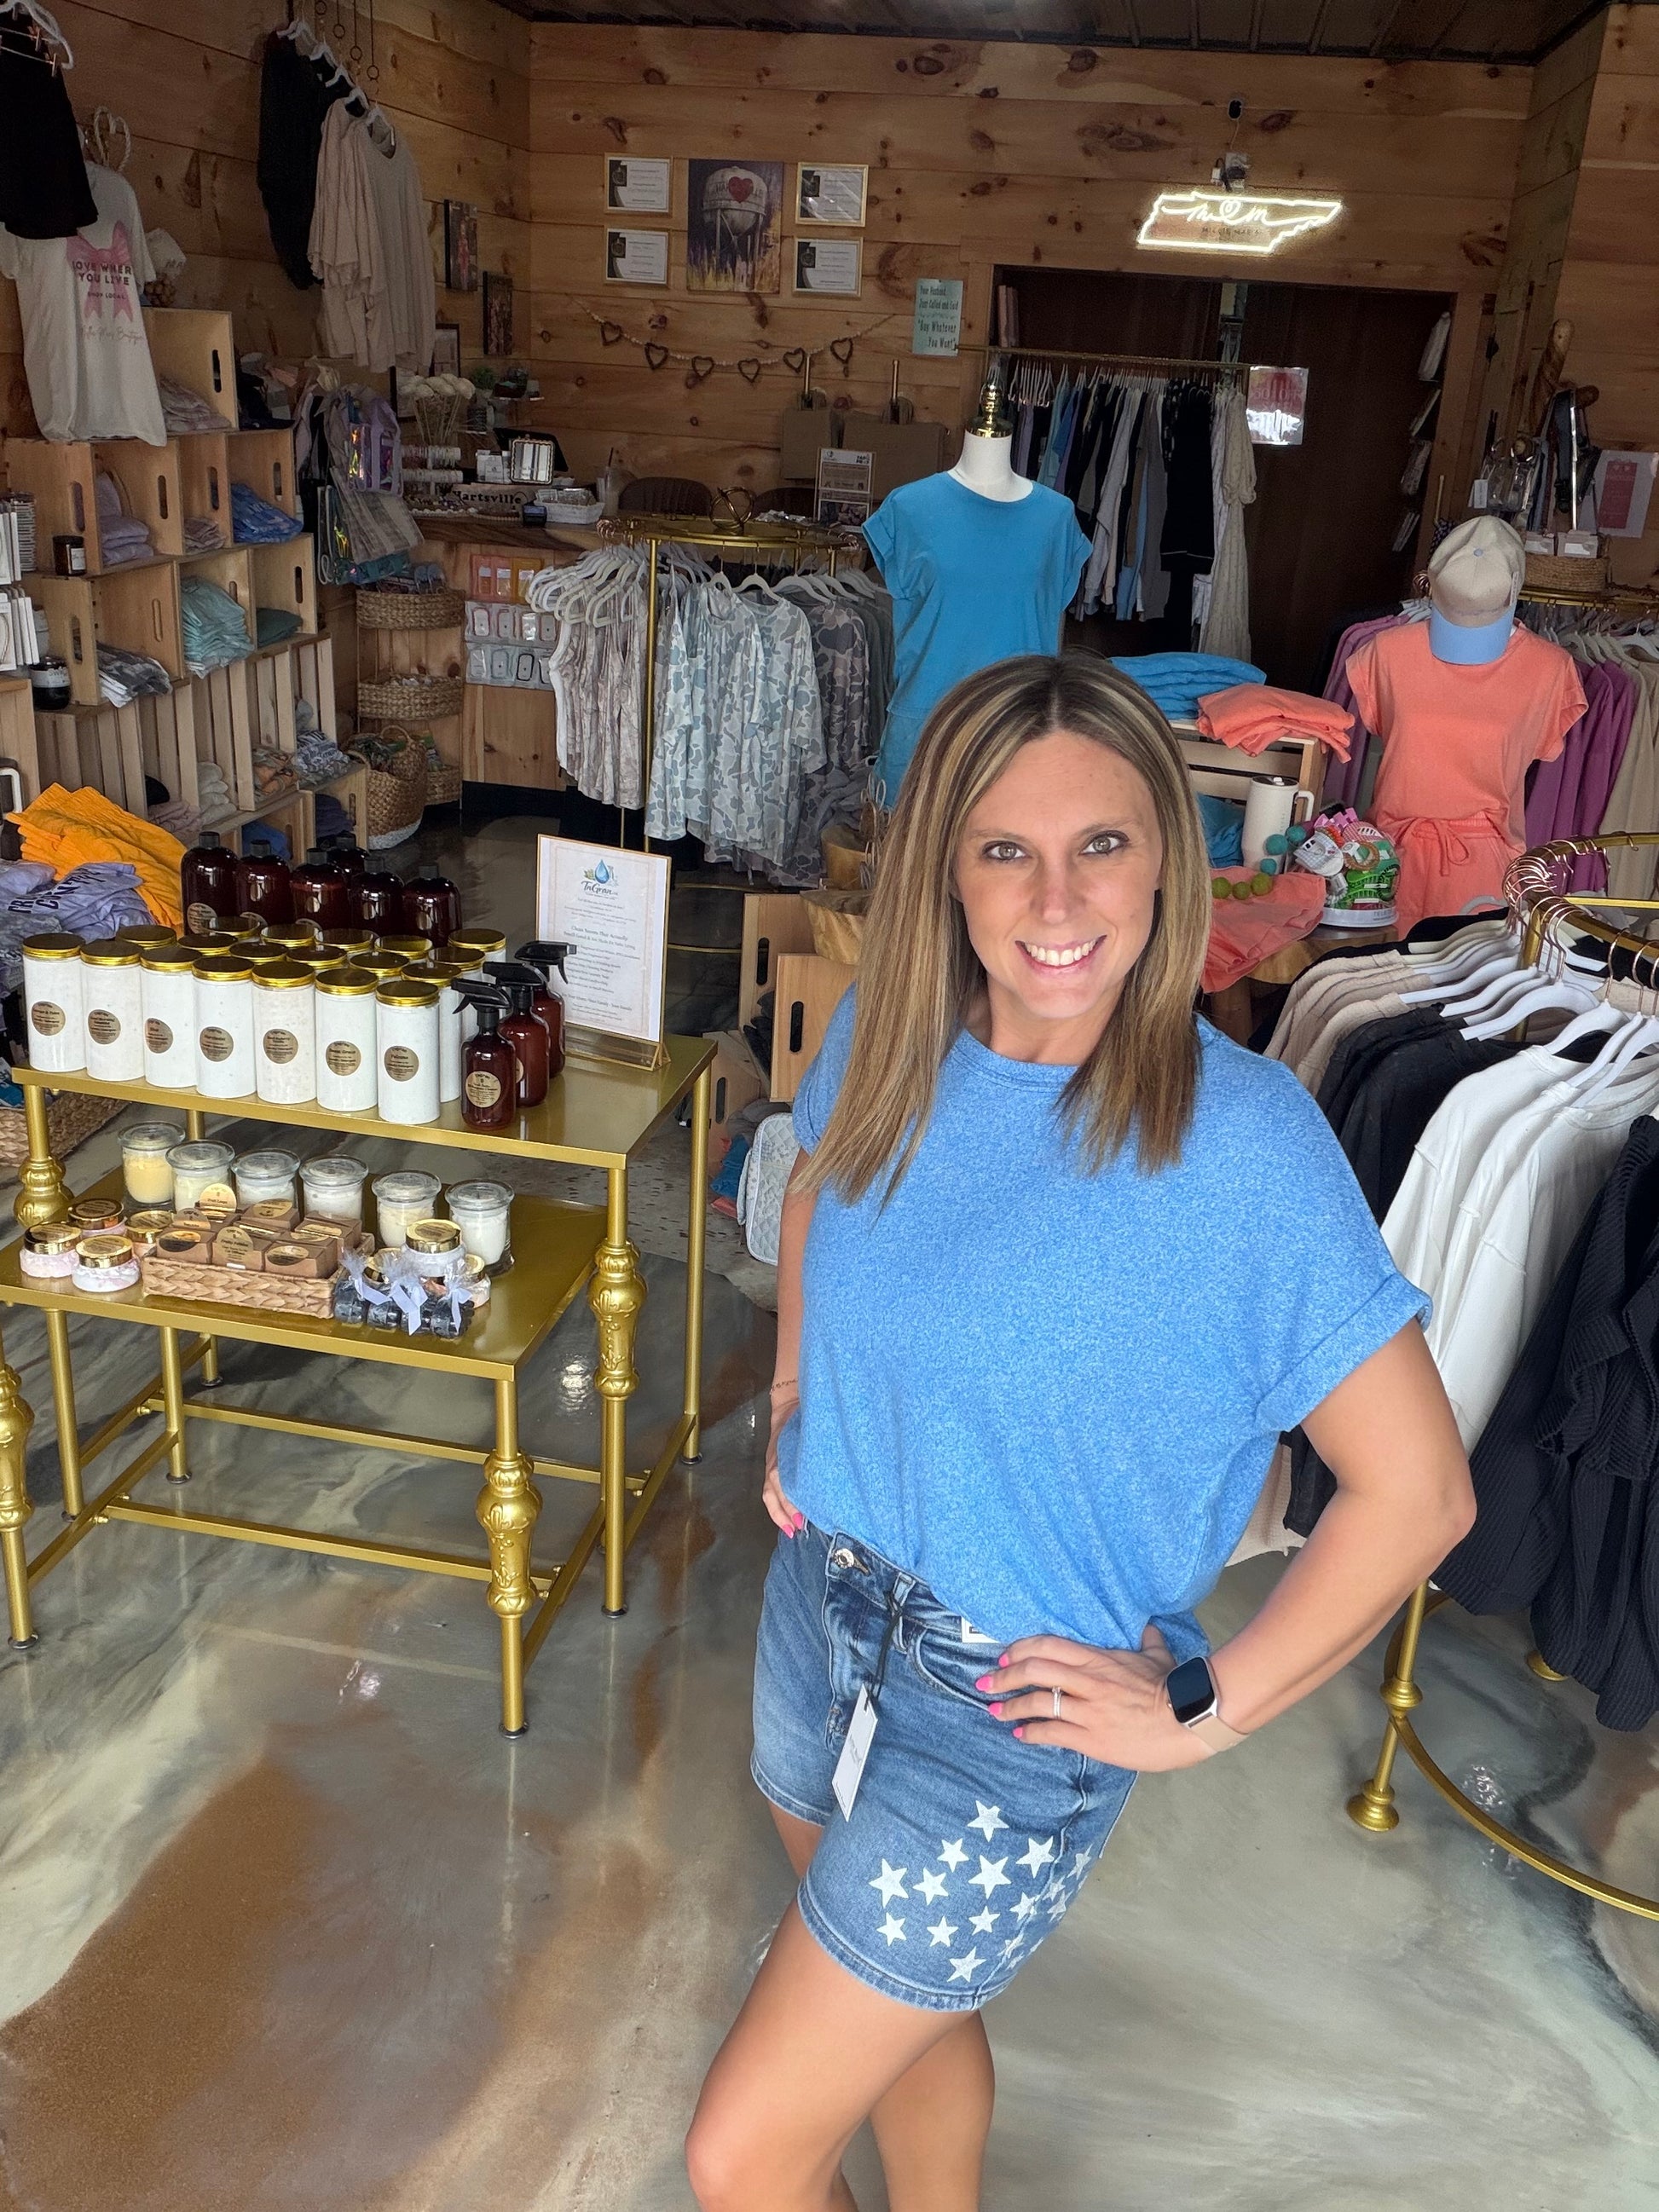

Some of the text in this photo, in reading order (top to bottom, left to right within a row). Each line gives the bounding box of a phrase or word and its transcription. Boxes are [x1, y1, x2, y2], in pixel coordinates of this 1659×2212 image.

[100, 262, 132, 274] WHER
[78, 273, 130, 286] YOU LIVE
